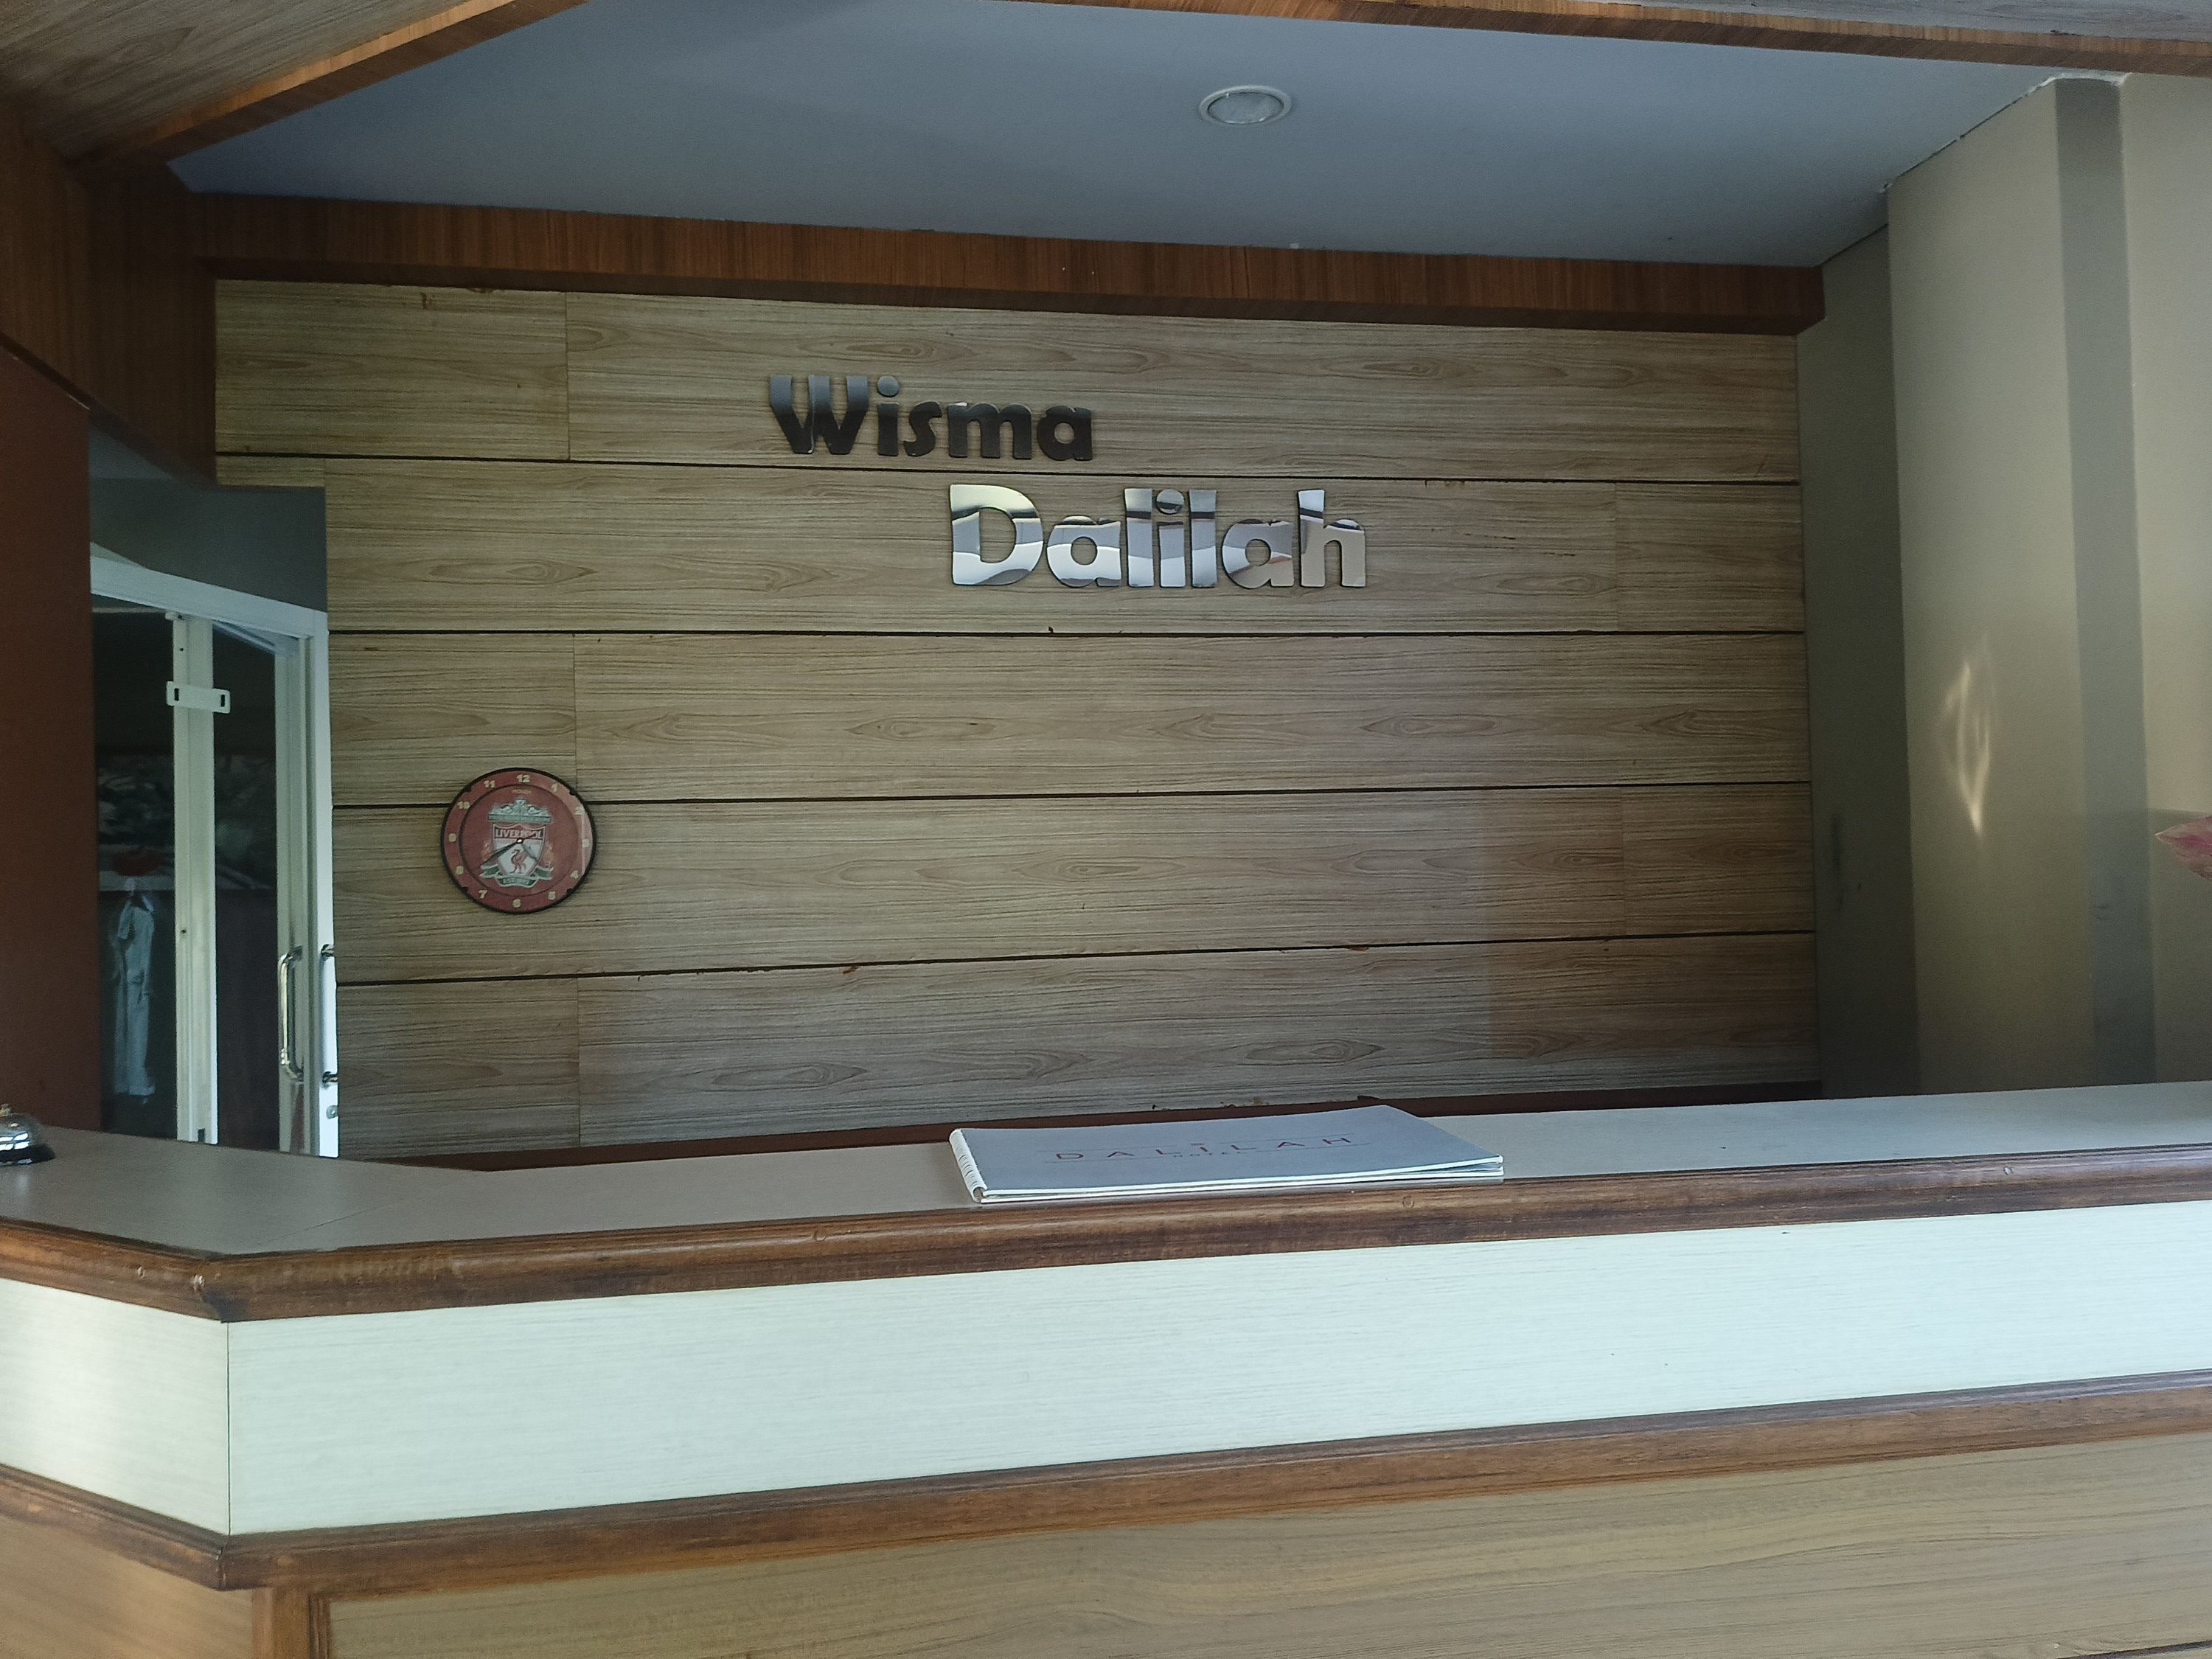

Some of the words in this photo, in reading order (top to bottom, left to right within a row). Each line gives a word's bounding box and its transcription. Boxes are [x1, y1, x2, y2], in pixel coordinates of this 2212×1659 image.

[769, 375, 1093, 462] Wisma
[949, 484, 1366, 588] Dalilah
[517, 774, 532, 783] 12
[479, 889, 487, 899] 7
